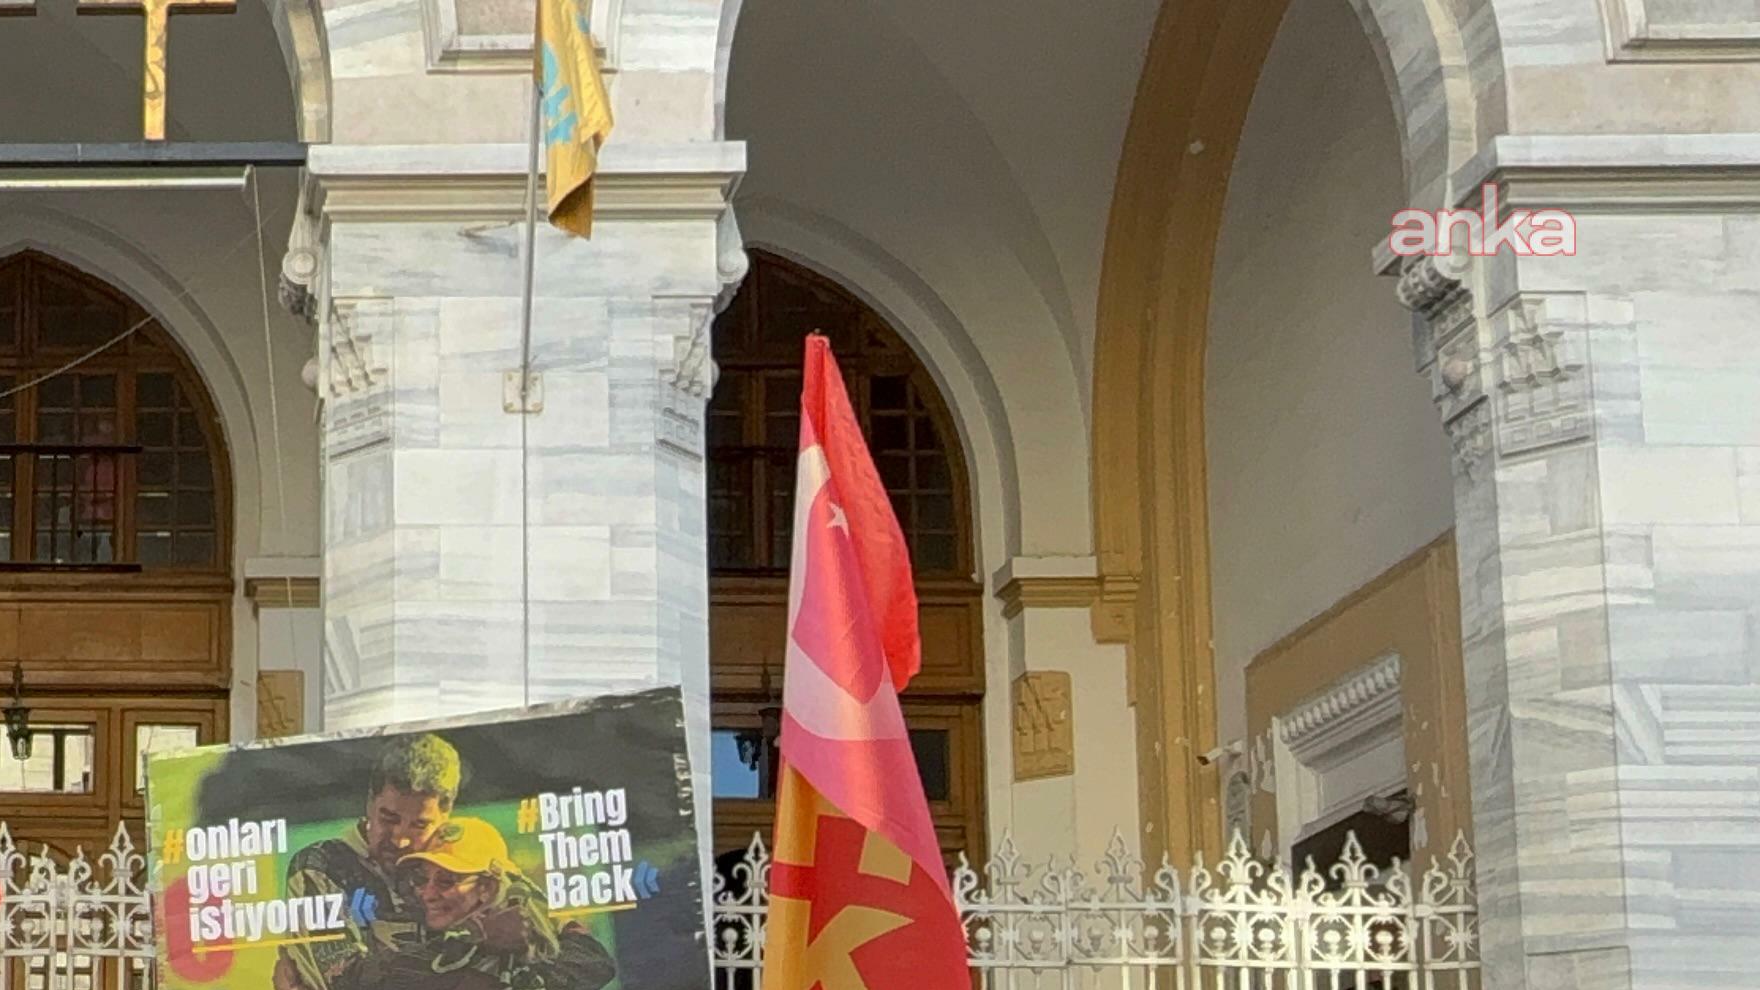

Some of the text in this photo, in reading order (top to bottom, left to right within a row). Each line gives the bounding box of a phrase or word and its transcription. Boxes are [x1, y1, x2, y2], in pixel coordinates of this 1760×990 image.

[517, 786, 627, 834] #Bring
[162, 817, 288, 865] #onları
[538, 828, 633, 871] Them
[187, 860, 259, 904] geri
[545, 864, 638, 911] Back
[189, 892, 345, 942] istiyoruz
